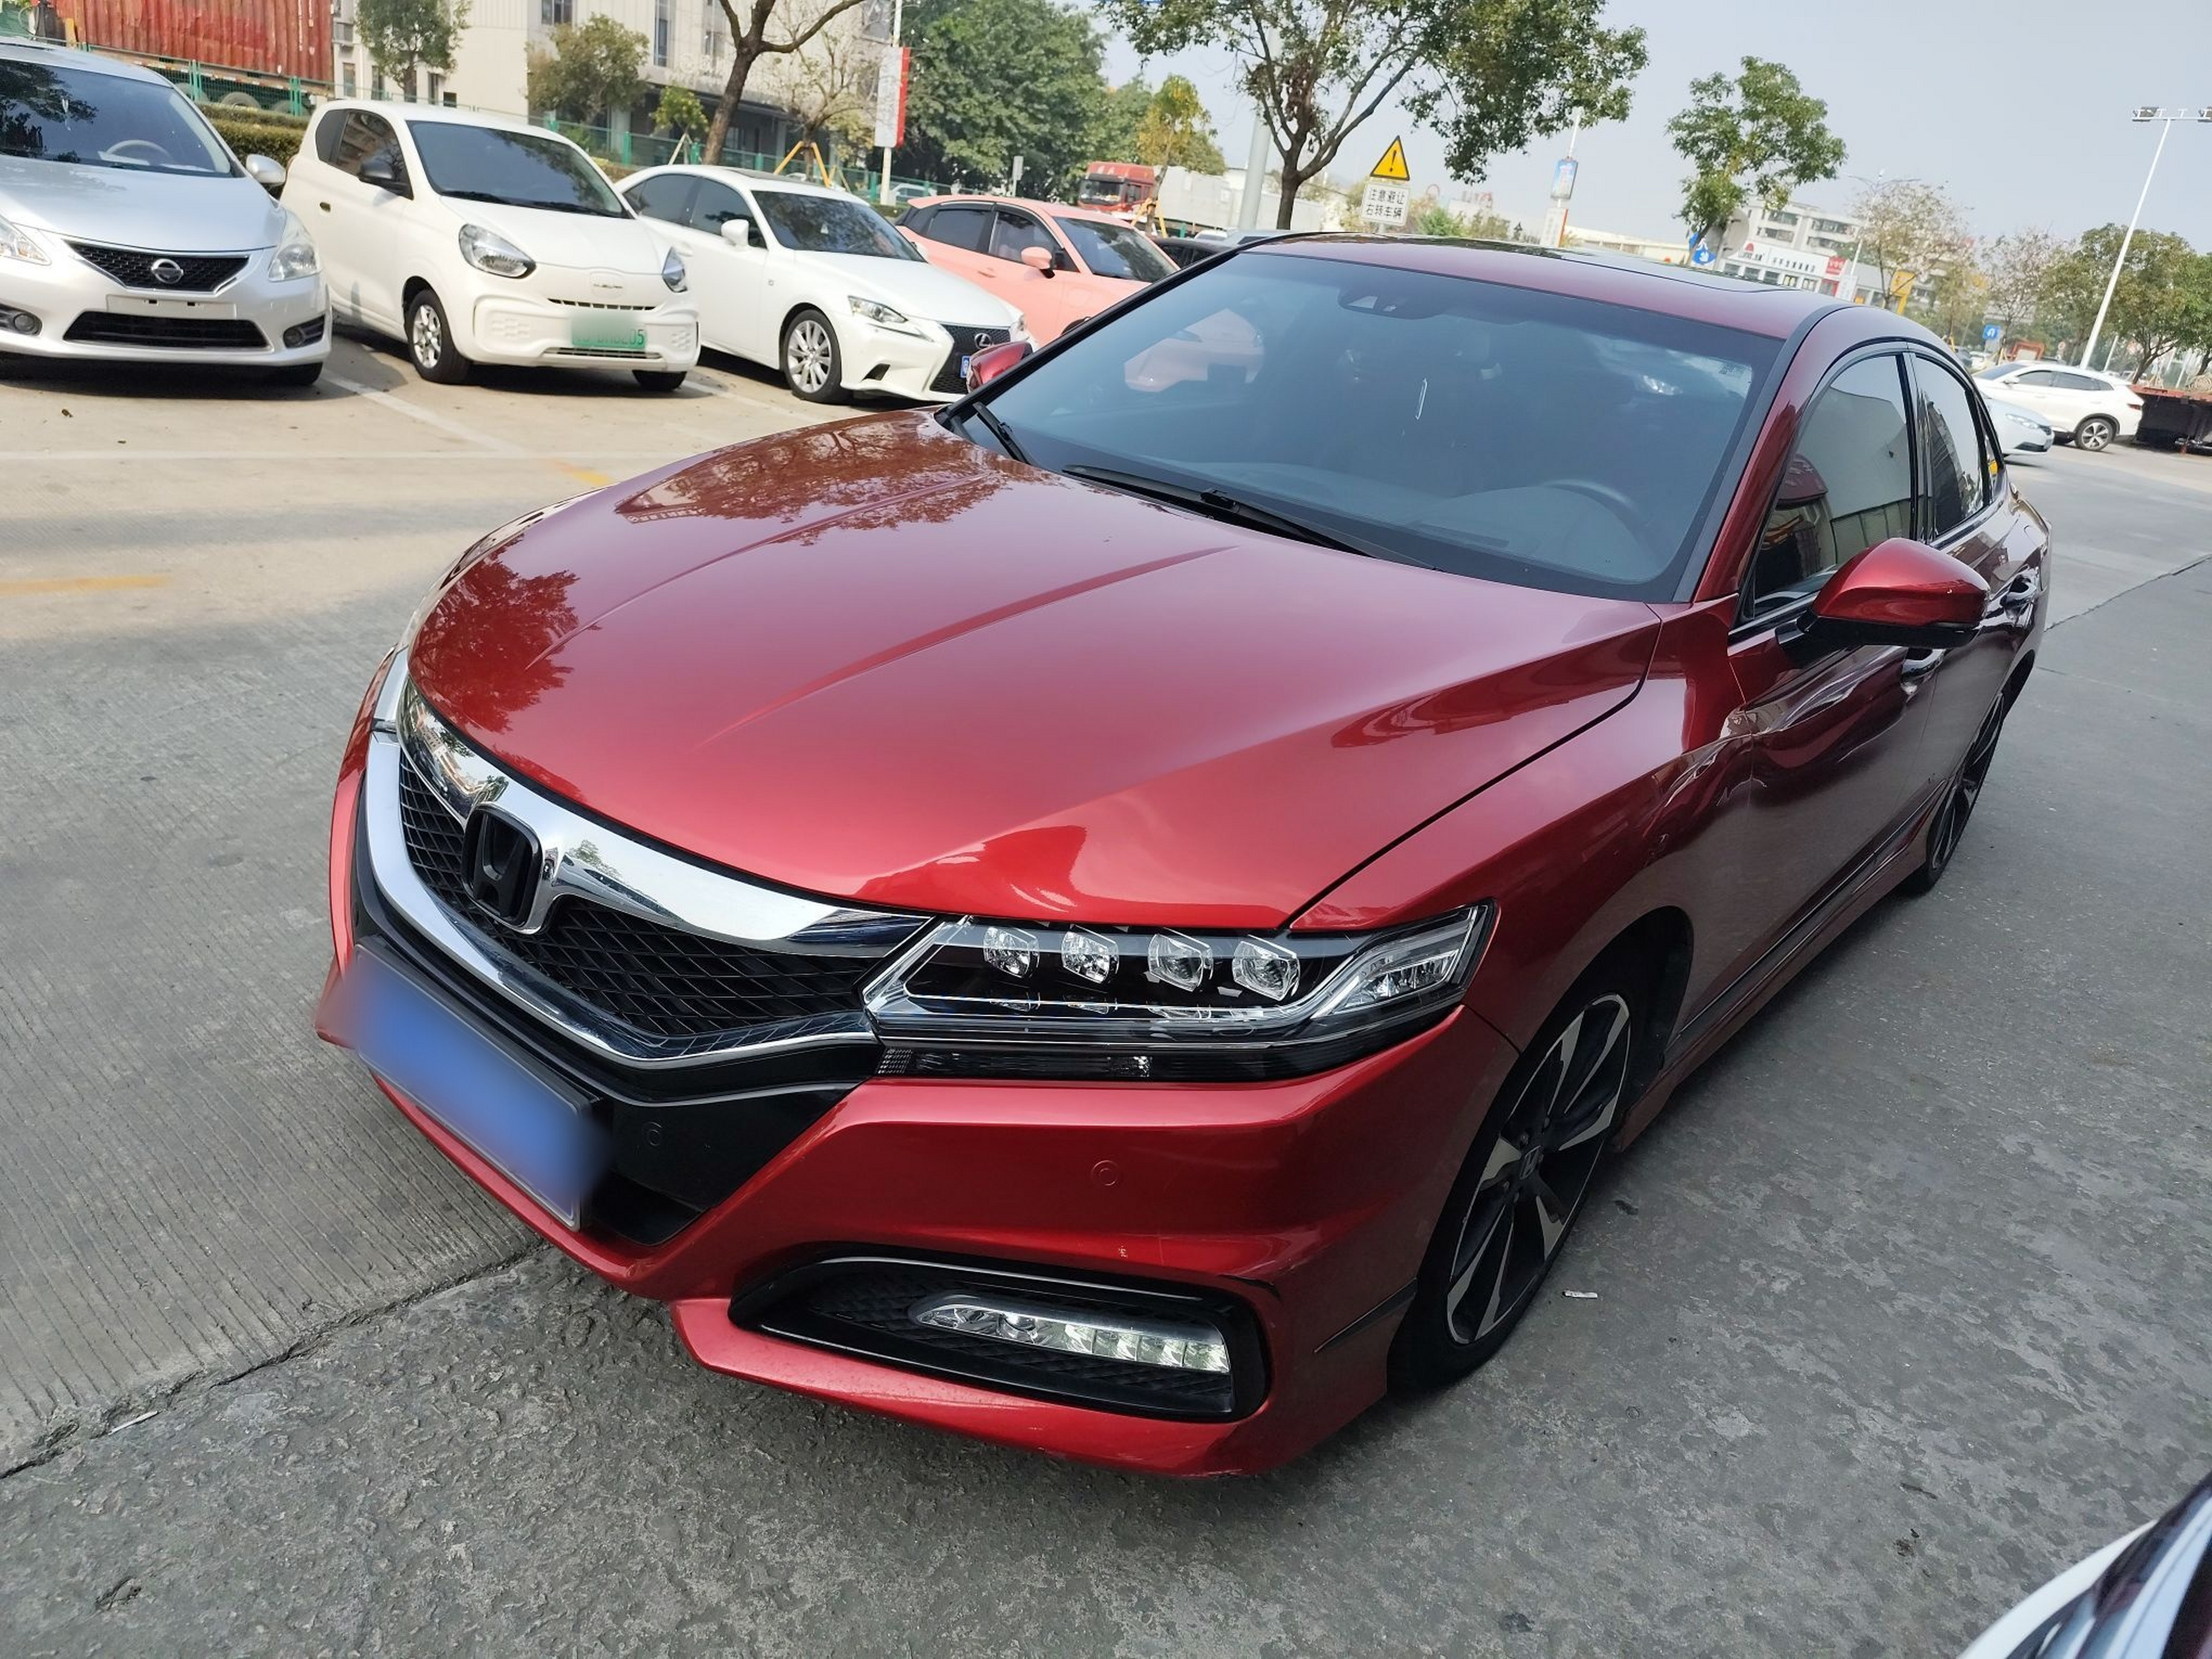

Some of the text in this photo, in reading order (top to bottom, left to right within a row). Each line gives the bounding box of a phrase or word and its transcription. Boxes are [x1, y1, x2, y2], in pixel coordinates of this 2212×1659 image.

[1369, 188, 1405, 204] 注意避让
[1365, 204, 1403, 218] 右转车辆
